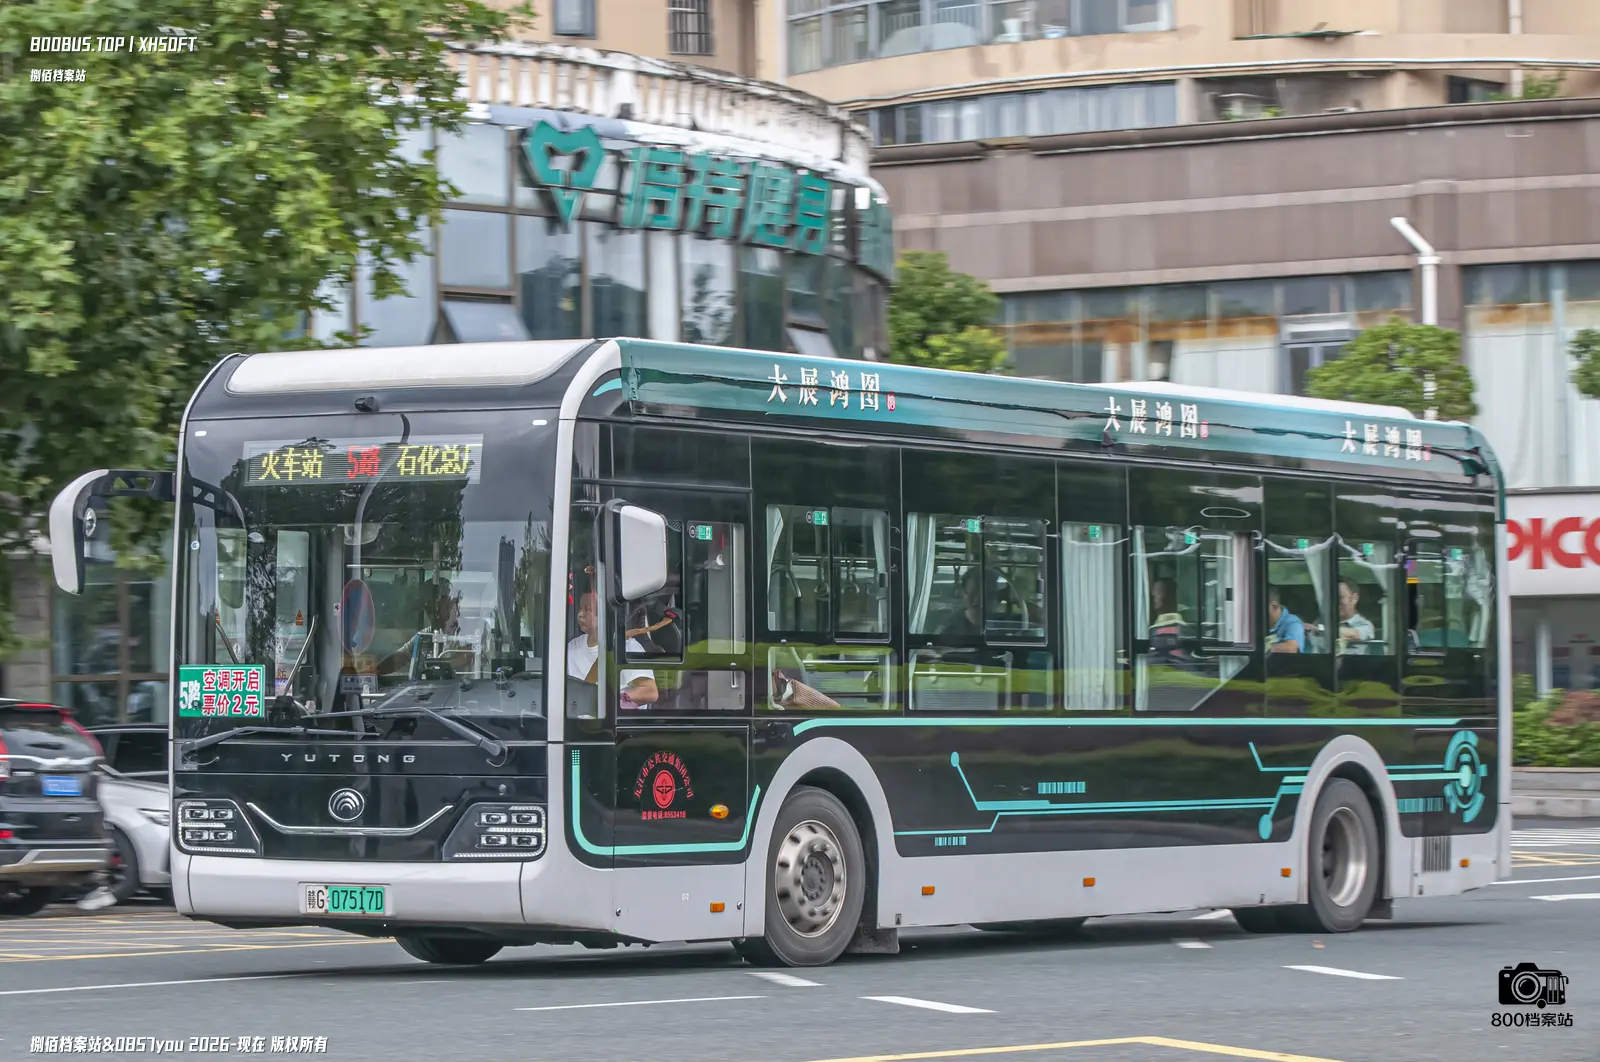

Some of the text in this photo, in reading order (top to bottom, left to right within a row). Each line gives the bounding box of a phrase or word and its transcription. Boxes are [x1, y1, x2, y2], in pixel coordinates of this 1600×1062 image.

[258, 447, 324, 480] 火车站
[202, 669, 260, 692] 空调开启
[202, 694, 260, 716] 票价2元
[281, 754, 416, 763] YUTONG
